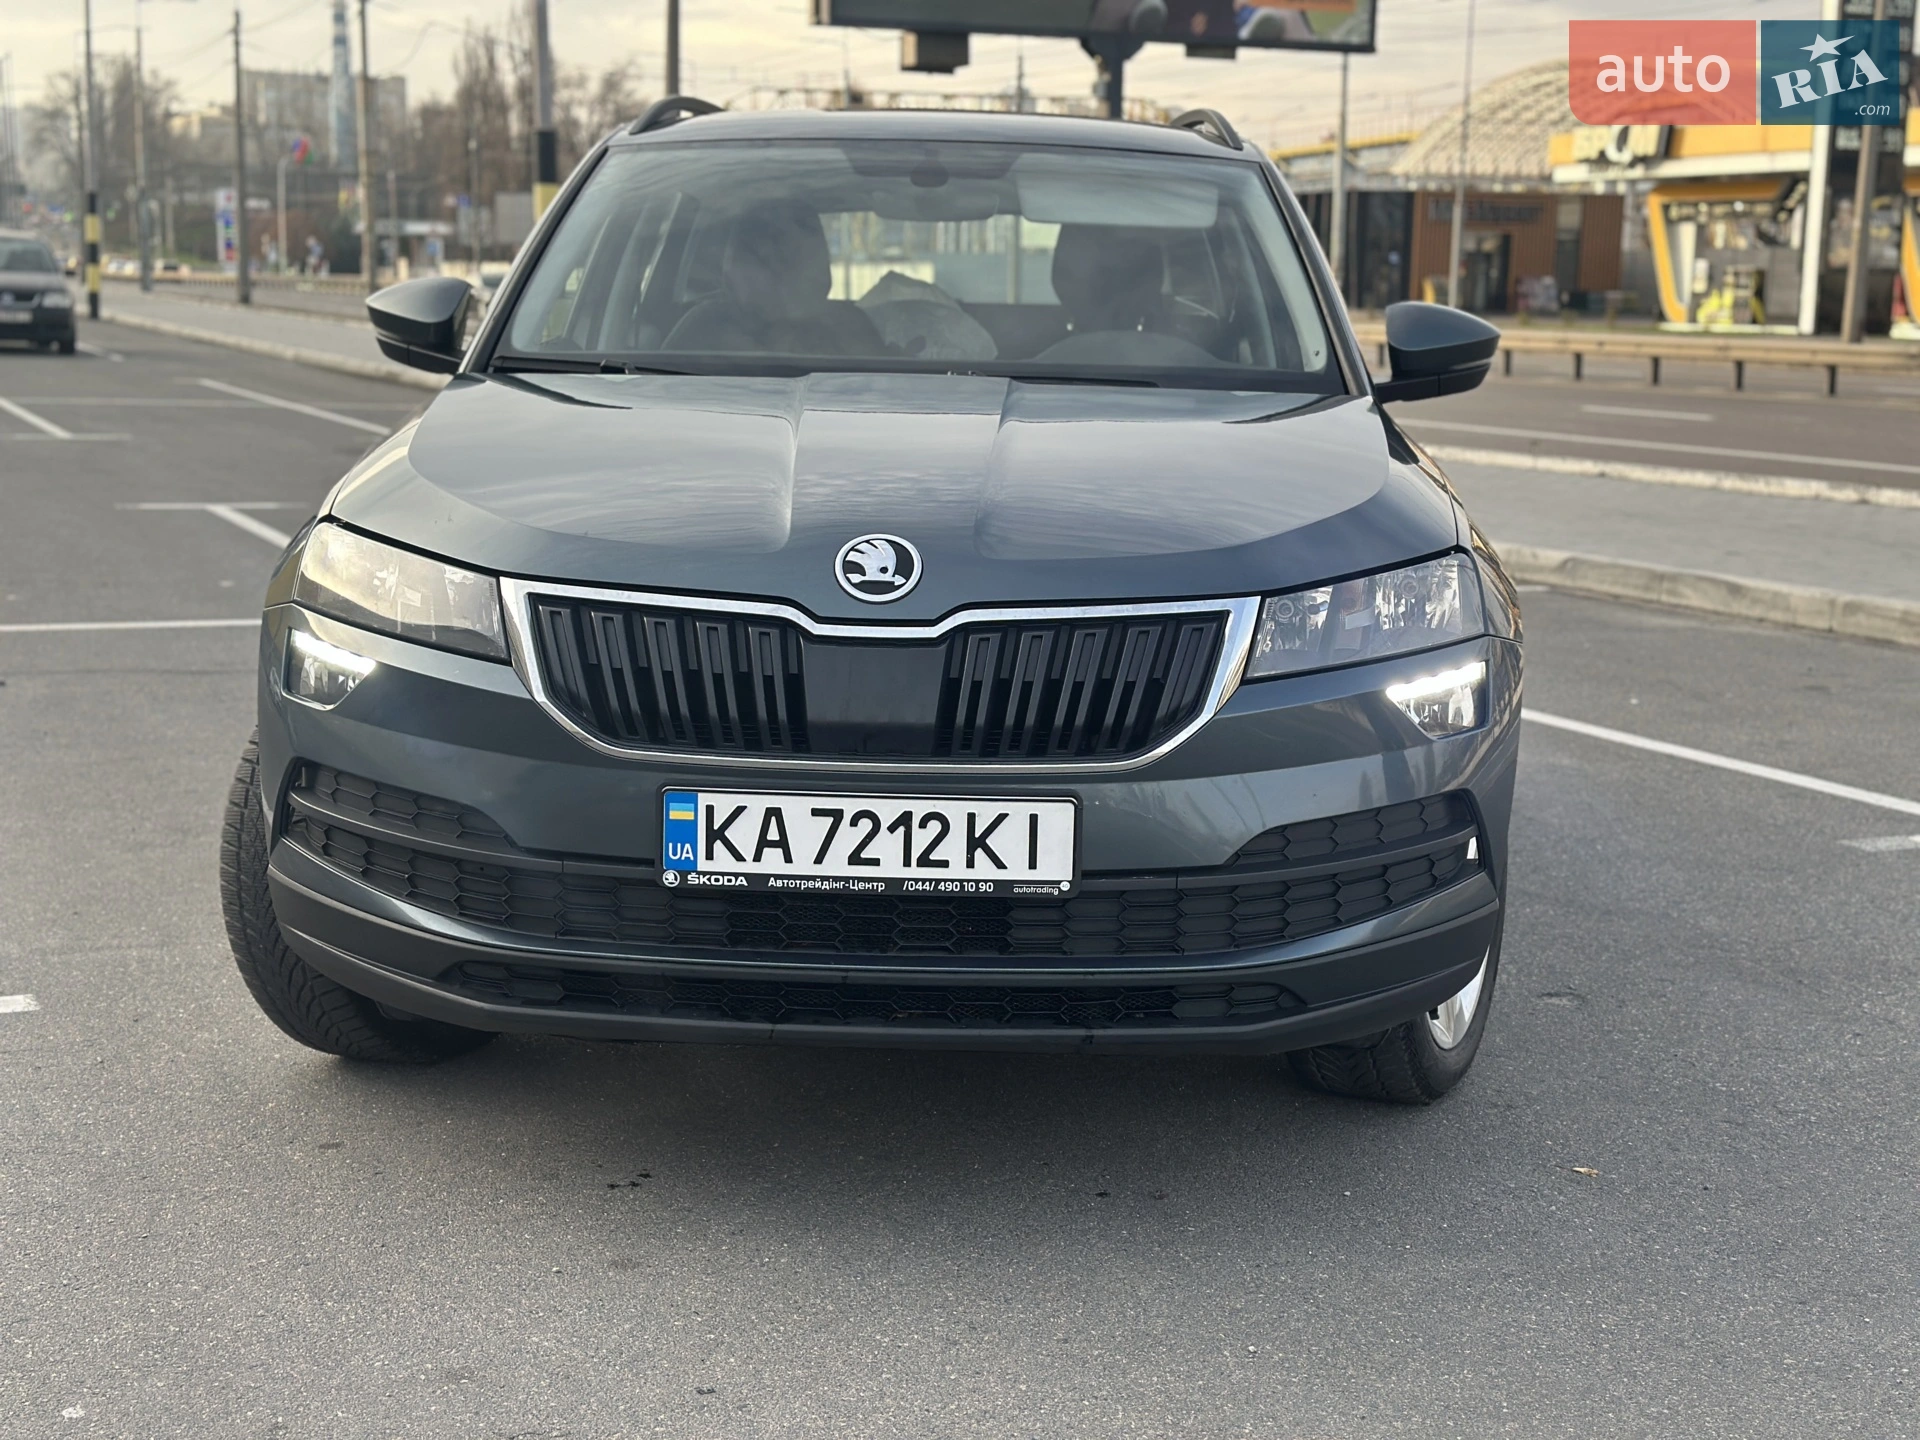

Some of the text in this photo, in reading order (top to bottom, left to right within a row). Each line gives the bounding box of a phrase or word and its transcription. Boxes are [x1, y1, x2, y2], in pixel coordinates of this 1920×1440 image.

[810, 808, 951, 867] 7212
[668, 842, 694, 860] UA
[687, 873, 748, 886] ŠKODA
[768, 877, 886, 891] Автотрейдінг-Центр
[902, 880, 994, 892] /044/ 490 10 90
[1013, 886, 1059, 895] autotrading
